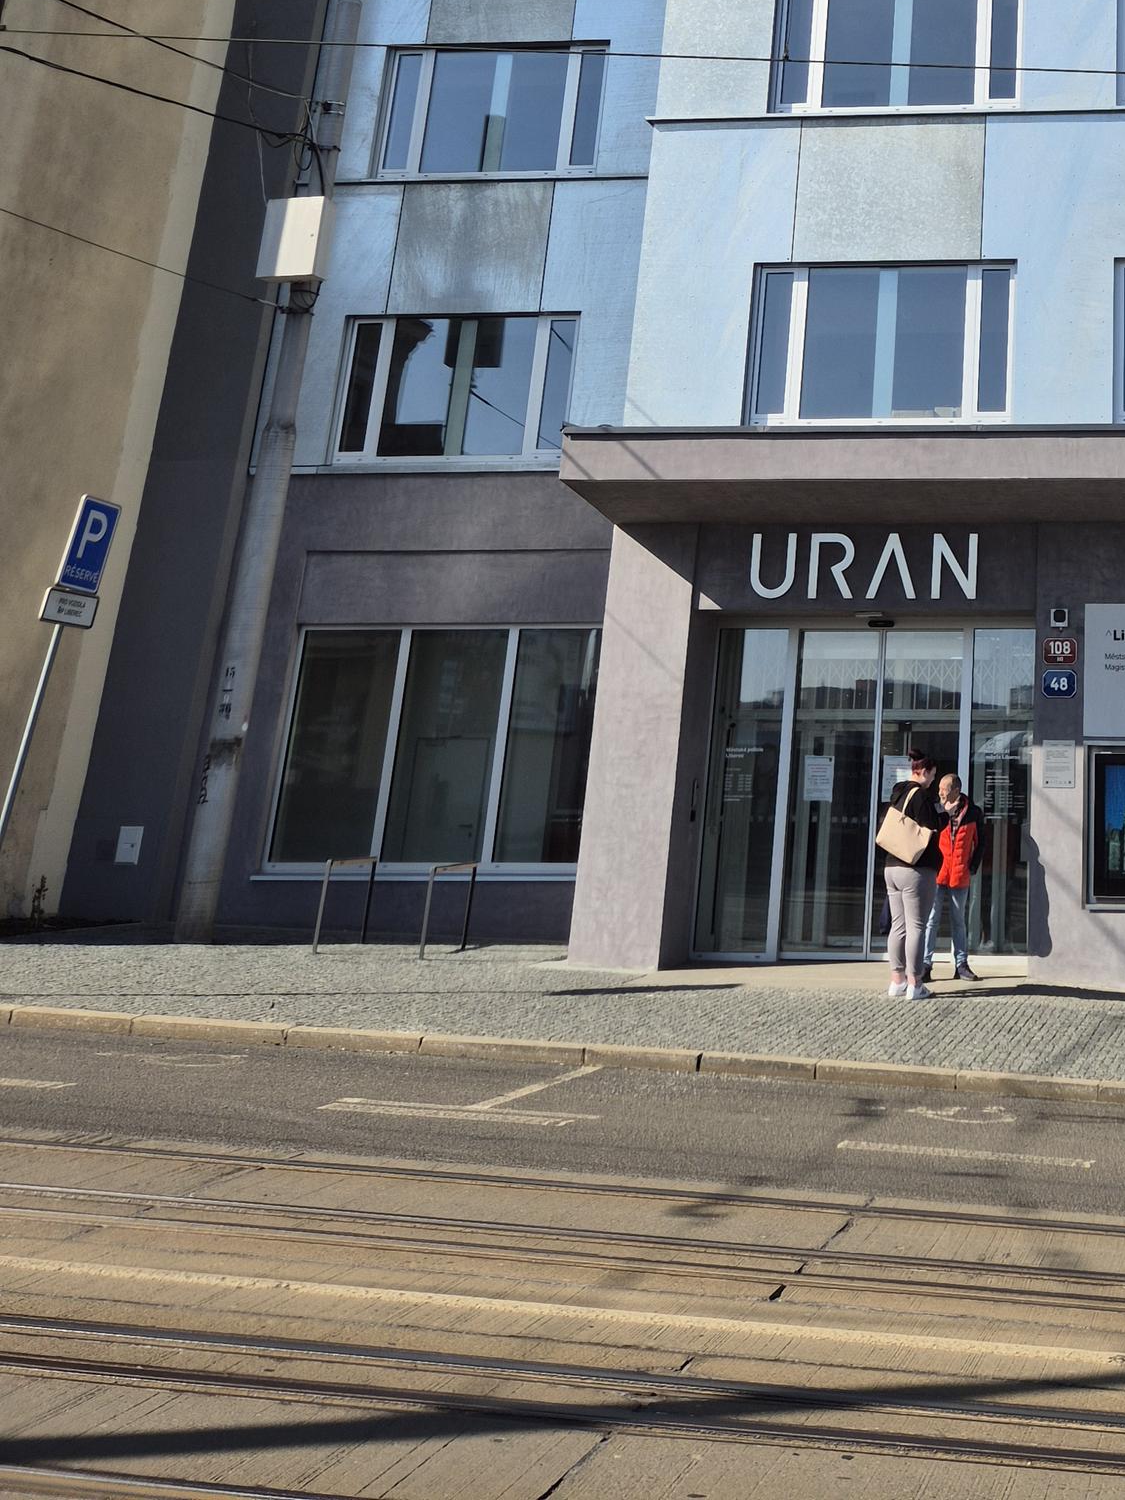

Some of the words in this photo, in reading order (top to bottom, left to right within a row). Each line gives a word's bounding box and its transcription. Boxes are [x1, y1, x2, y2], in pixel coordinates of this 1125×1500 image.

[76, 509, 108, 559] P
[750, 533, 978, 599] URAN
[1049, 641, 1071, 654] 108
[1050, 677, 1068, 691] 48
